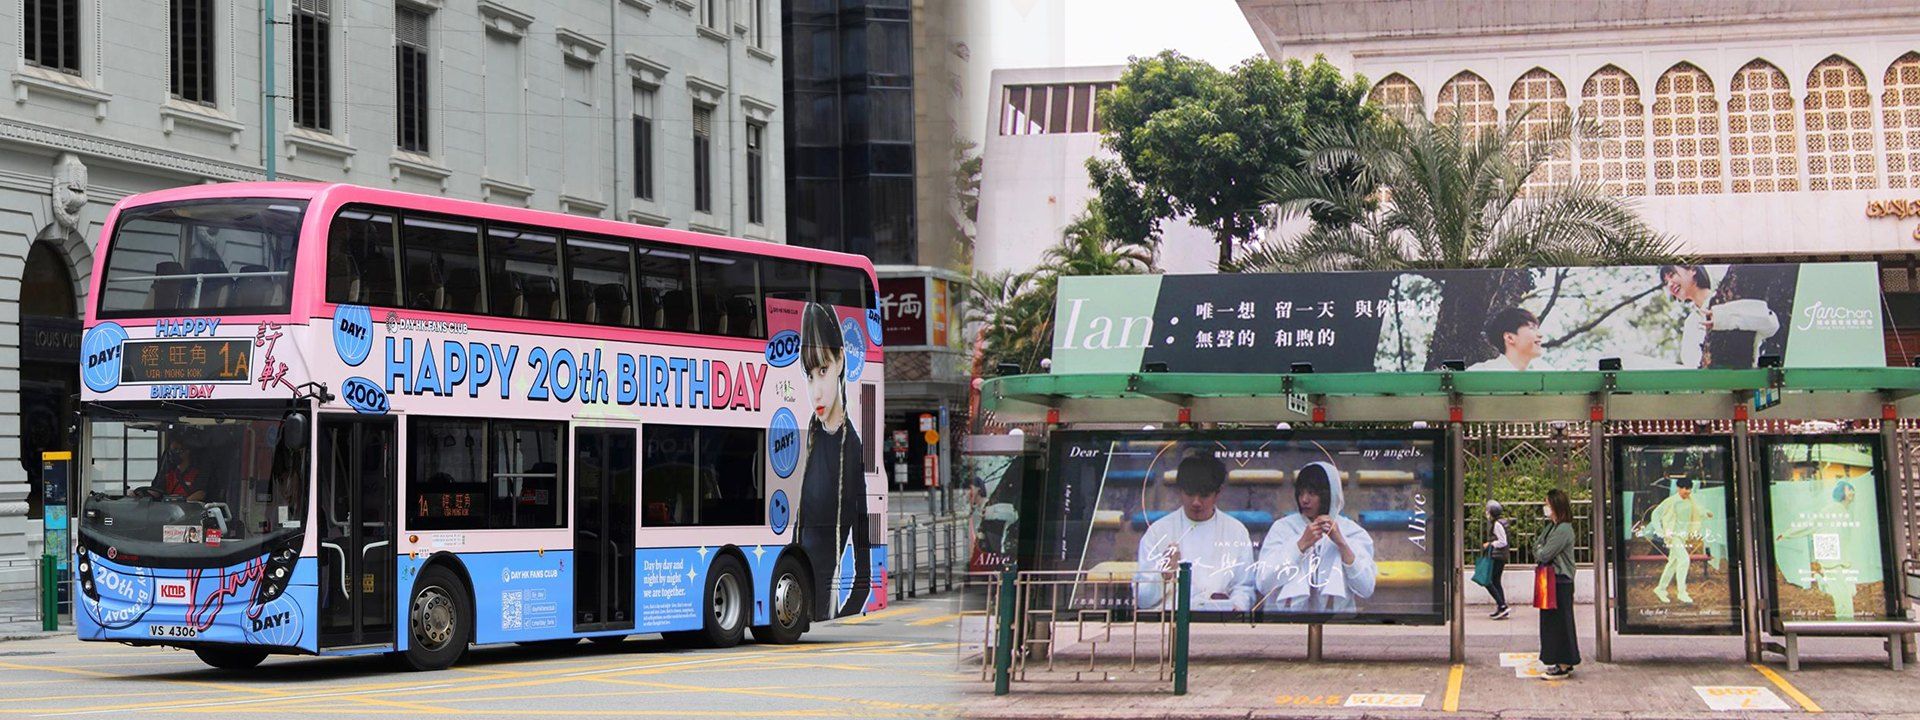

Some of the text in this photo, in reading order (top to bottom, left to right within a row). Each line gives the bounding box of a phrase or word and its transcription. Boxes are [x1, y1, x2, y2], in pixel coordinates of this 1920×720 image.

[1196, 302, 1255, 320] 唯一想
[1275, 301, 1335, 319] 留一天
[155, 318, 221, 337] HAPPY
[340, 318, 367, 340] DAY!
[400, 318, 468, 334] DAY HK FANS CLUB
[35, 329, 60, 347] LOUIS
[769, 334, 800, 361] 2002
[1196, 329, 1255, 347] 無聲的
[89, 345, 120, 369] DAY!
[141, 344, 207, 367] 經 旺角
[218, 341, 249, 378] 1A
[146, 369, 202, 378] VIA MONG KOK
[385, 336, 768, 412] HAPPY 20th BIRTHDAY
[150, 384, 216, 399] BIRTHDAY
[346, 380, 386, 411] 2002
[774, 433, 795, 454] DAY!
[1069, 446, 1424, 460] Dear my angels.
[418, 494, 429, 517] 1A
[1408, 493, 1427, 551] Alive
[644, 558, 684, 573] Day by day and
[975, 553, 1011, 566] Alive
[96, 567, 135, 599] 20th
[511, 570, 521, 579] DAY
[530, 570, 544, 578] FANS
[544, 569, 558, 578] CLUB
[644, 572, 659, 587] night
[667, 572, 682, 586] night
[161, 584, 186, 598] KMB
[643, 585, 686, 600] we are together.
[252, 611, 290, 632] DAY!
[151, 625, 196, 638] VS 4306
